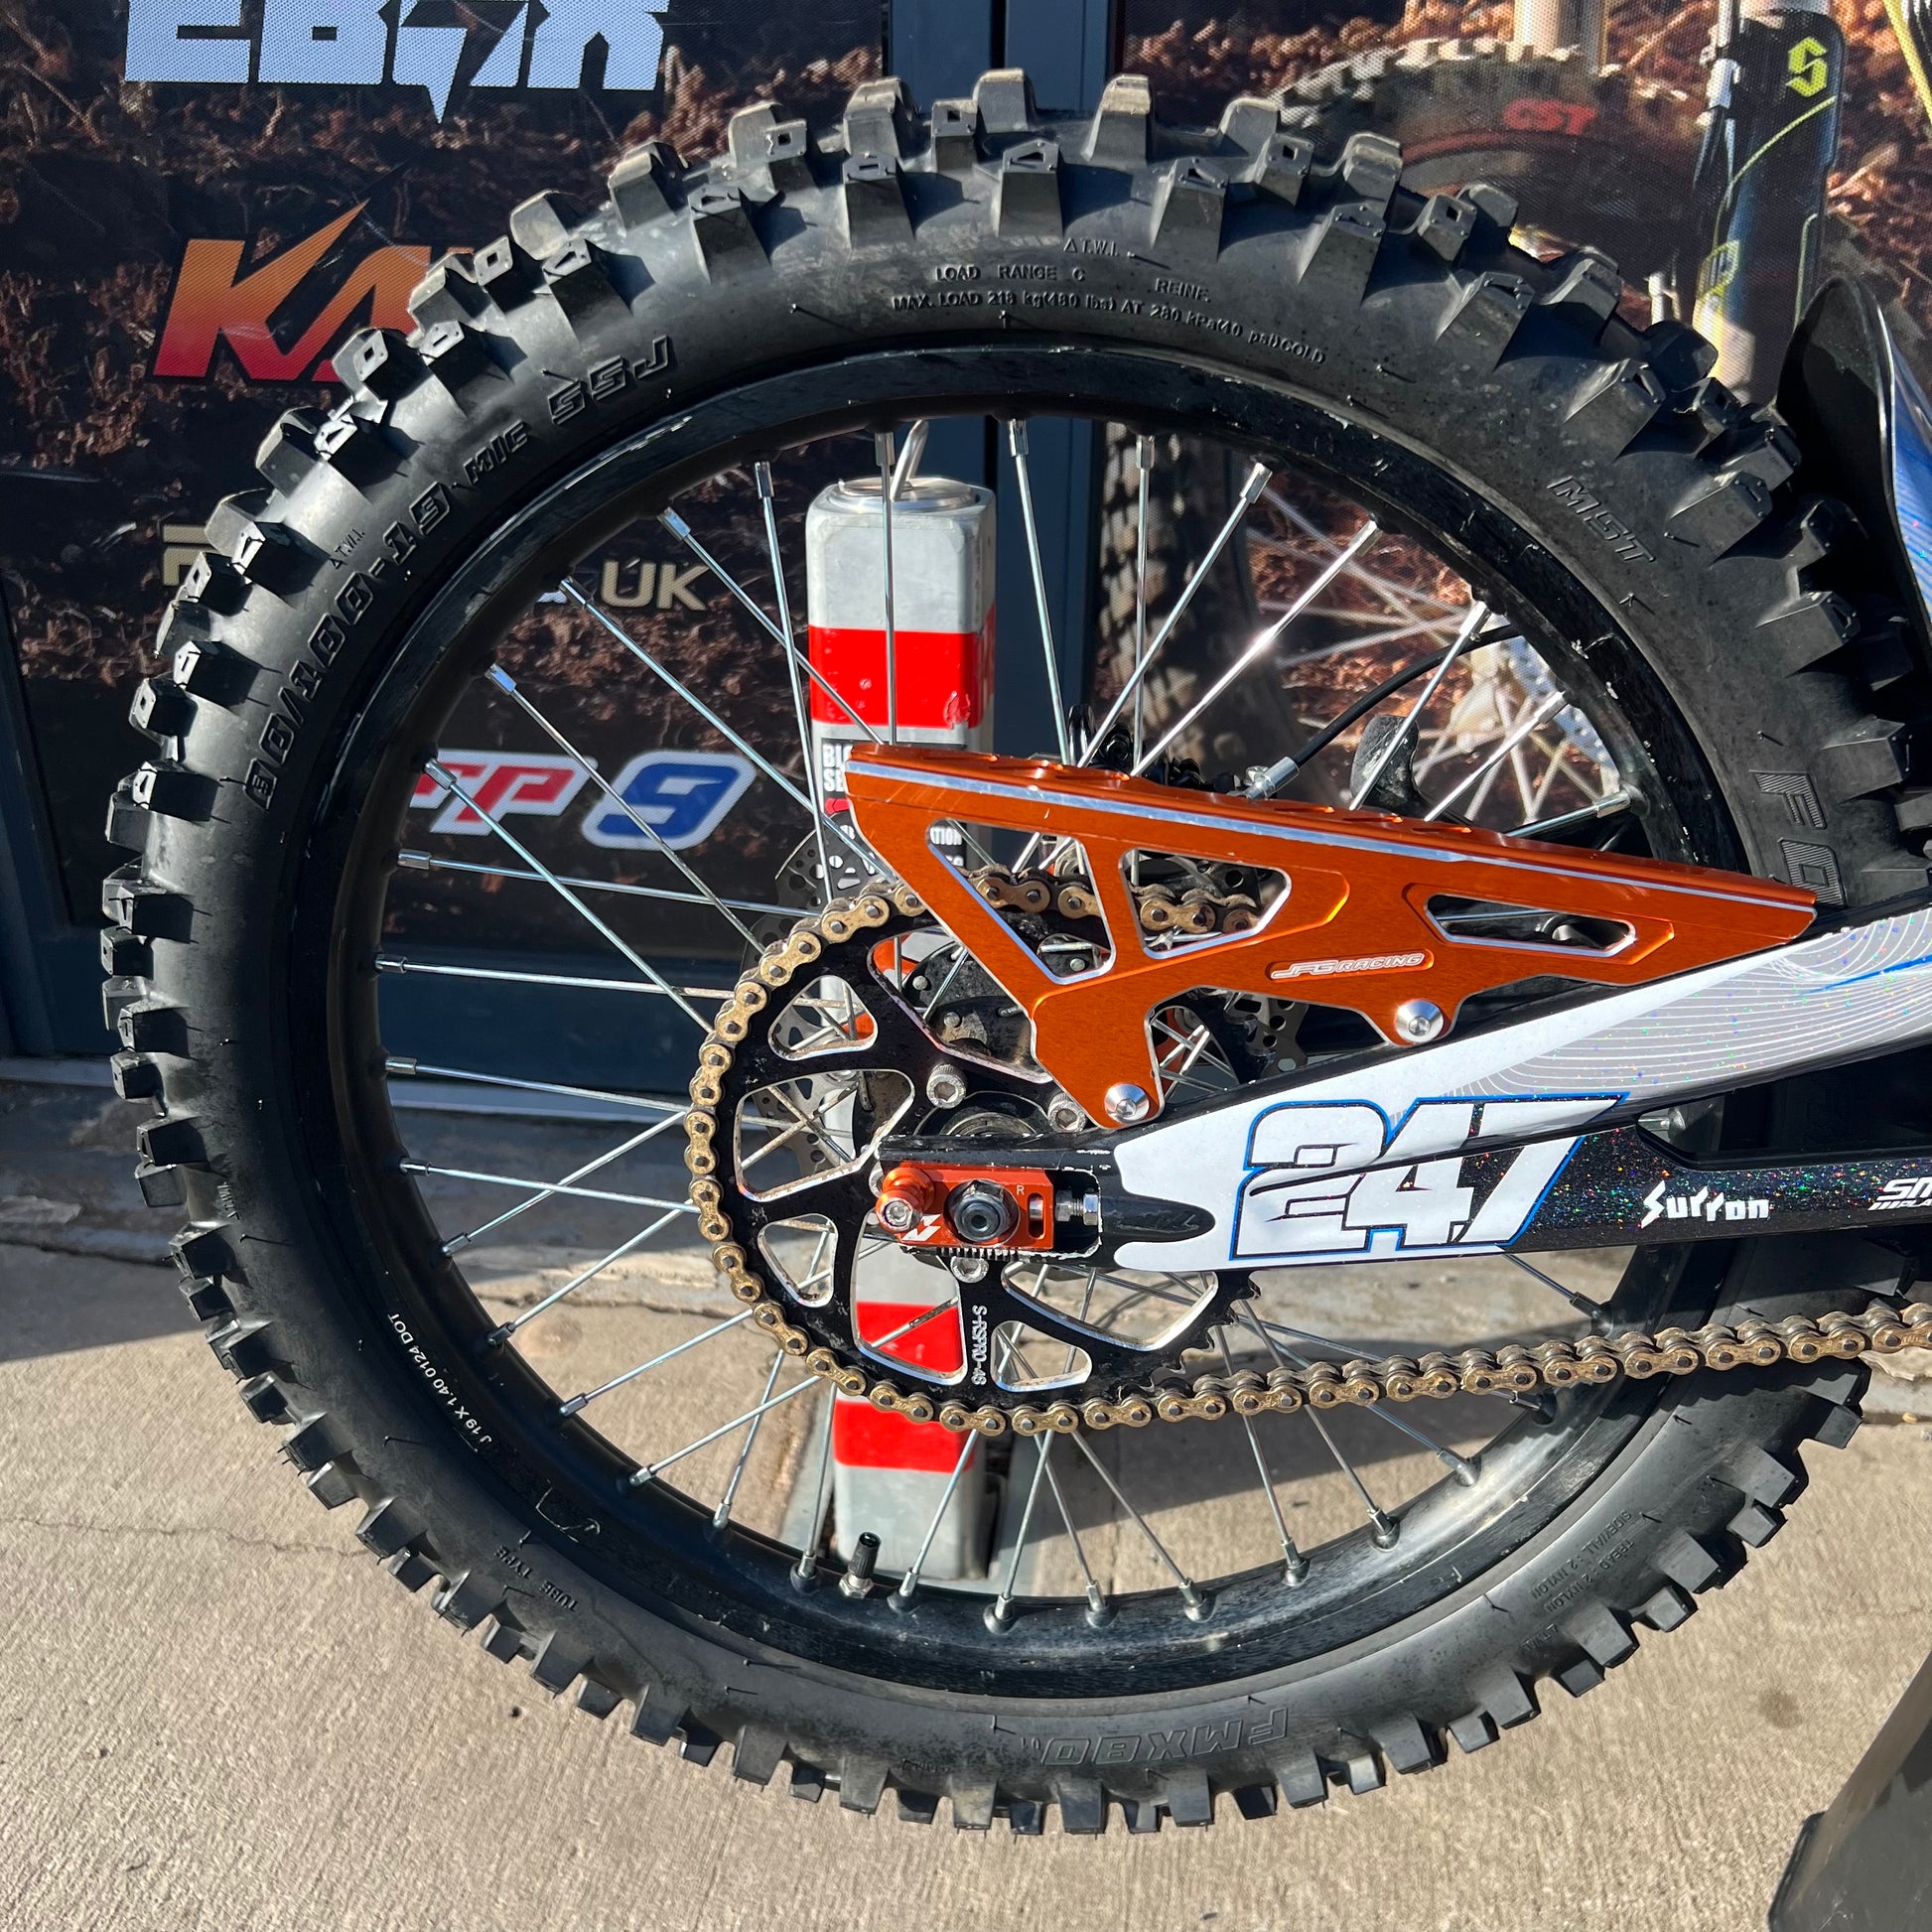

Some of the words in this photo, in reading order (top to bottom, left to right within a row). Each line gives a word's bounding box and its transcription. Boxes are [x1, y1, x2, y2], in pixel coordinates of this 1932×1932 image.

[1503, 98, 1596, 136] CST
[935, 263, 982, 282] LOAD
[997, 264, 1057, 281] RANGE
[153, 198, 475, 383] KA
[892, 293, 935, 311] MAX.
[938, 290, 982, 307] LOAD
[1121, 299, 1144, 315] AT
[1547, 475, 1656, 563] MST
[601, 559, 709, 611] UK
[1336, 953, 1425, 973] RACING
[1016, 1184, 1026, 1196] R
[387, 1313, 414, 1344] DOT
[408, 1345, 437, 1378] 0124
[433, 1378, 459, 1407] 1.40
[454, 1405, 471, 1420] X
[1582, 1509, 1633, 1555] SIDEWALL
[493, 1545, 533, 1580] TYPE
[1598, 1538, 1636, 1571] TREAD
[539, 1581, 580, 1612] TUBE
[1530, 1566, 1569, 1599] NYLON
[1543, 1580, 1585, 1613] NYLON
[1040, 1706, 1290, 1766] FMX80
